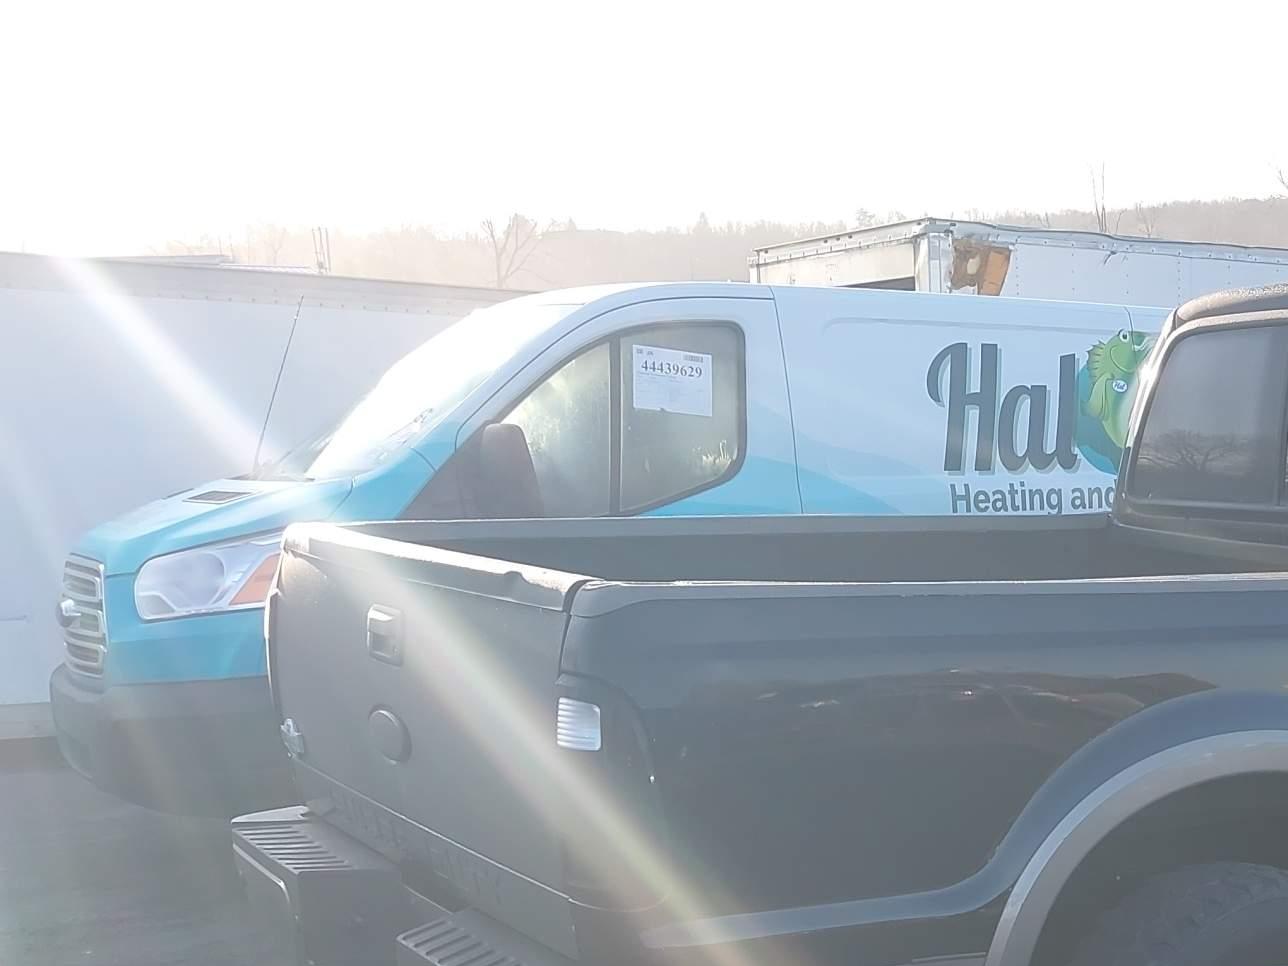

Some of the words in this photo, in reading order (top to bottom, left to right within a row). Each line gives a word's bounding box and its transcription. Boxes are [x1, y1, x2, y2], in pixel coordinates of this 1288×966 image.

[641, 359, 703, 378] 44439629
[926, 342, 1079, 473] Hal
[950, 480, 1063, 515] Heating
